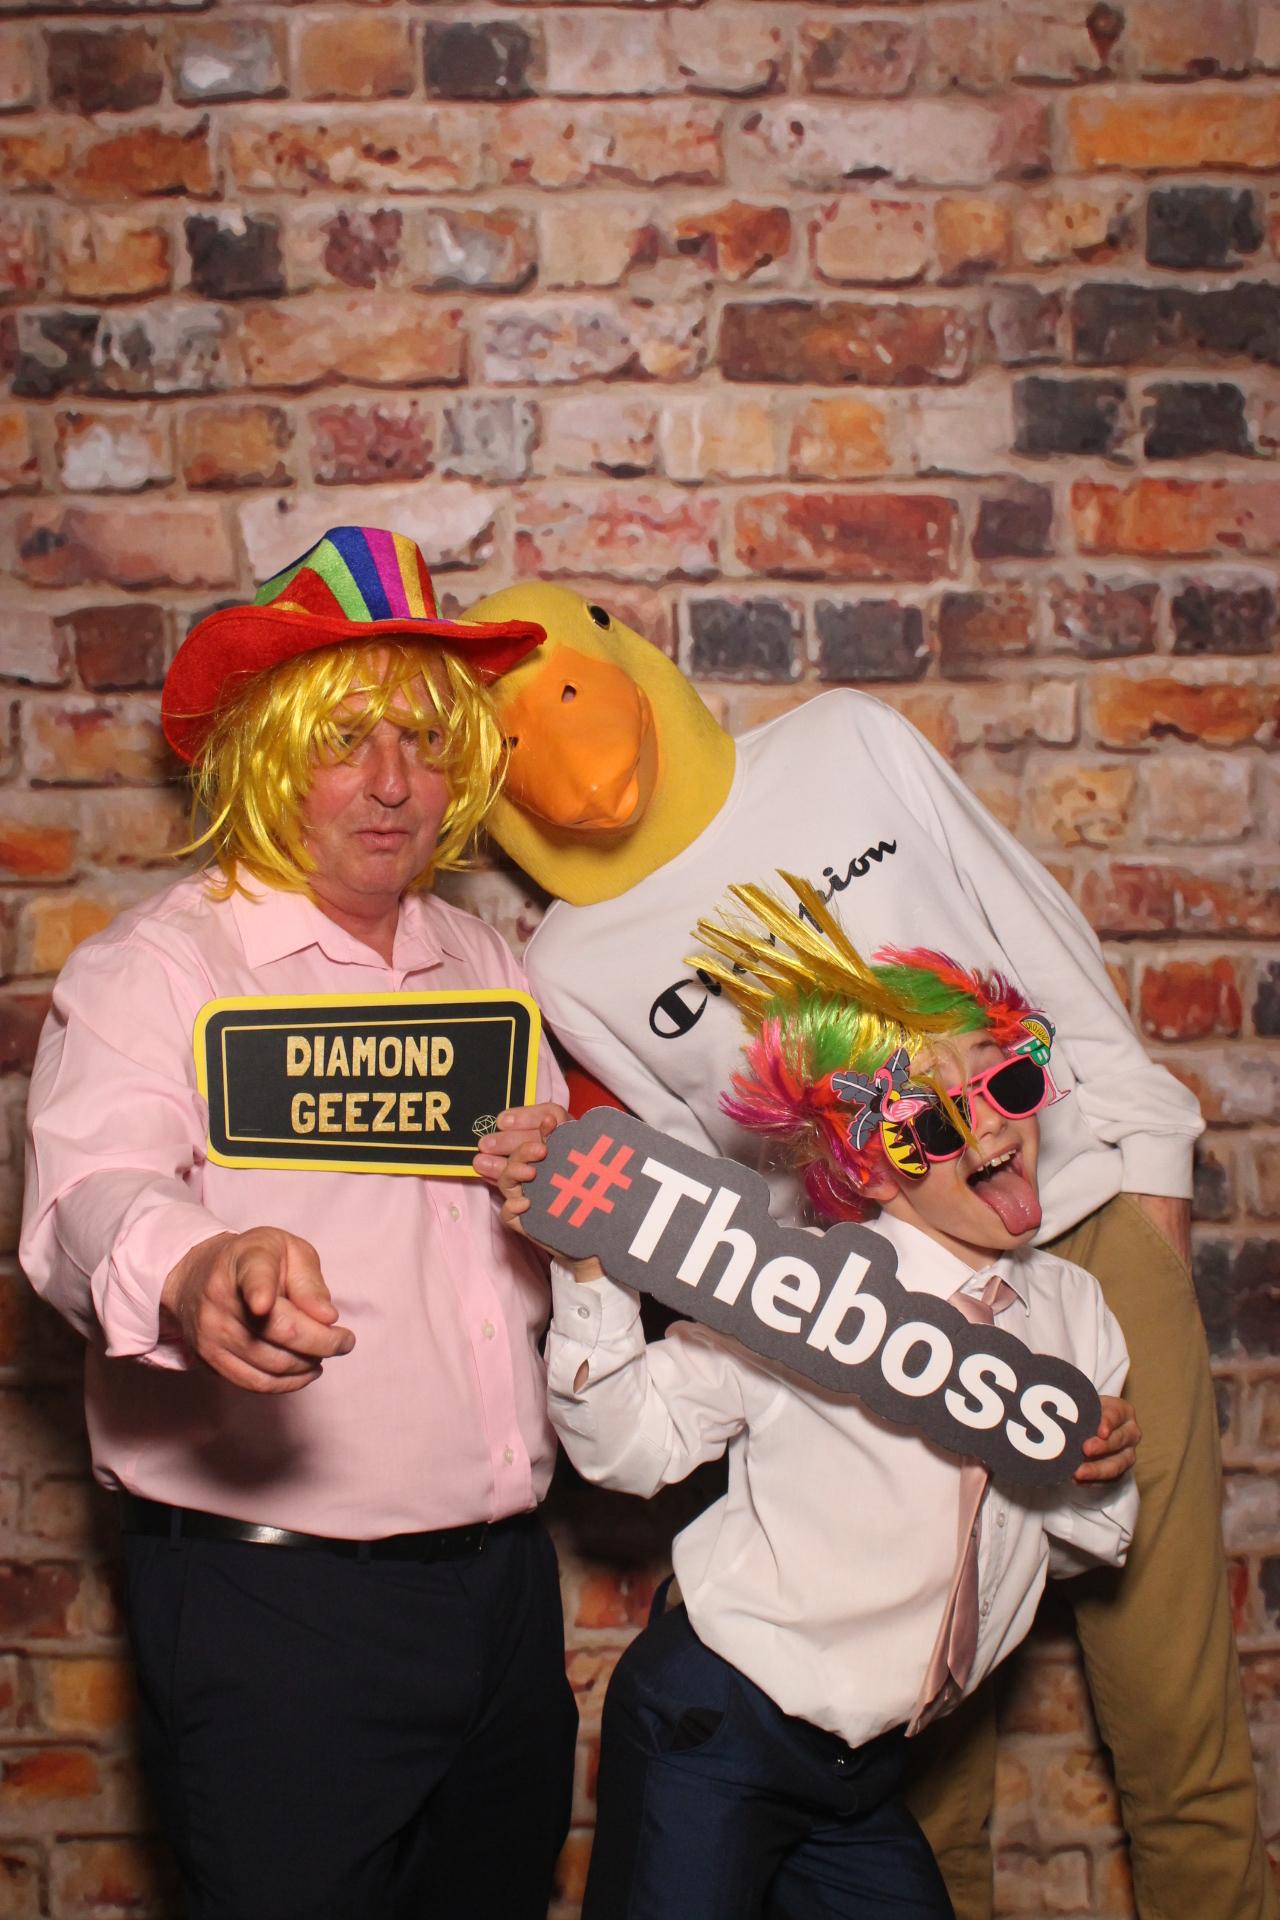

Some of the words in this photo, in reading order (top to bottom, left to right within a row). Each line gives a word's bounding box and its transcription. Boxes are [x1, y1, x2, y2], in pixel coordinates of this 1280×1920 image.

[286, 1036, 454, 1077] DIAMOND
[291, 1091, 451, 1133] GEEZER
[548, 1134, 1079, 1461] #Theboss
